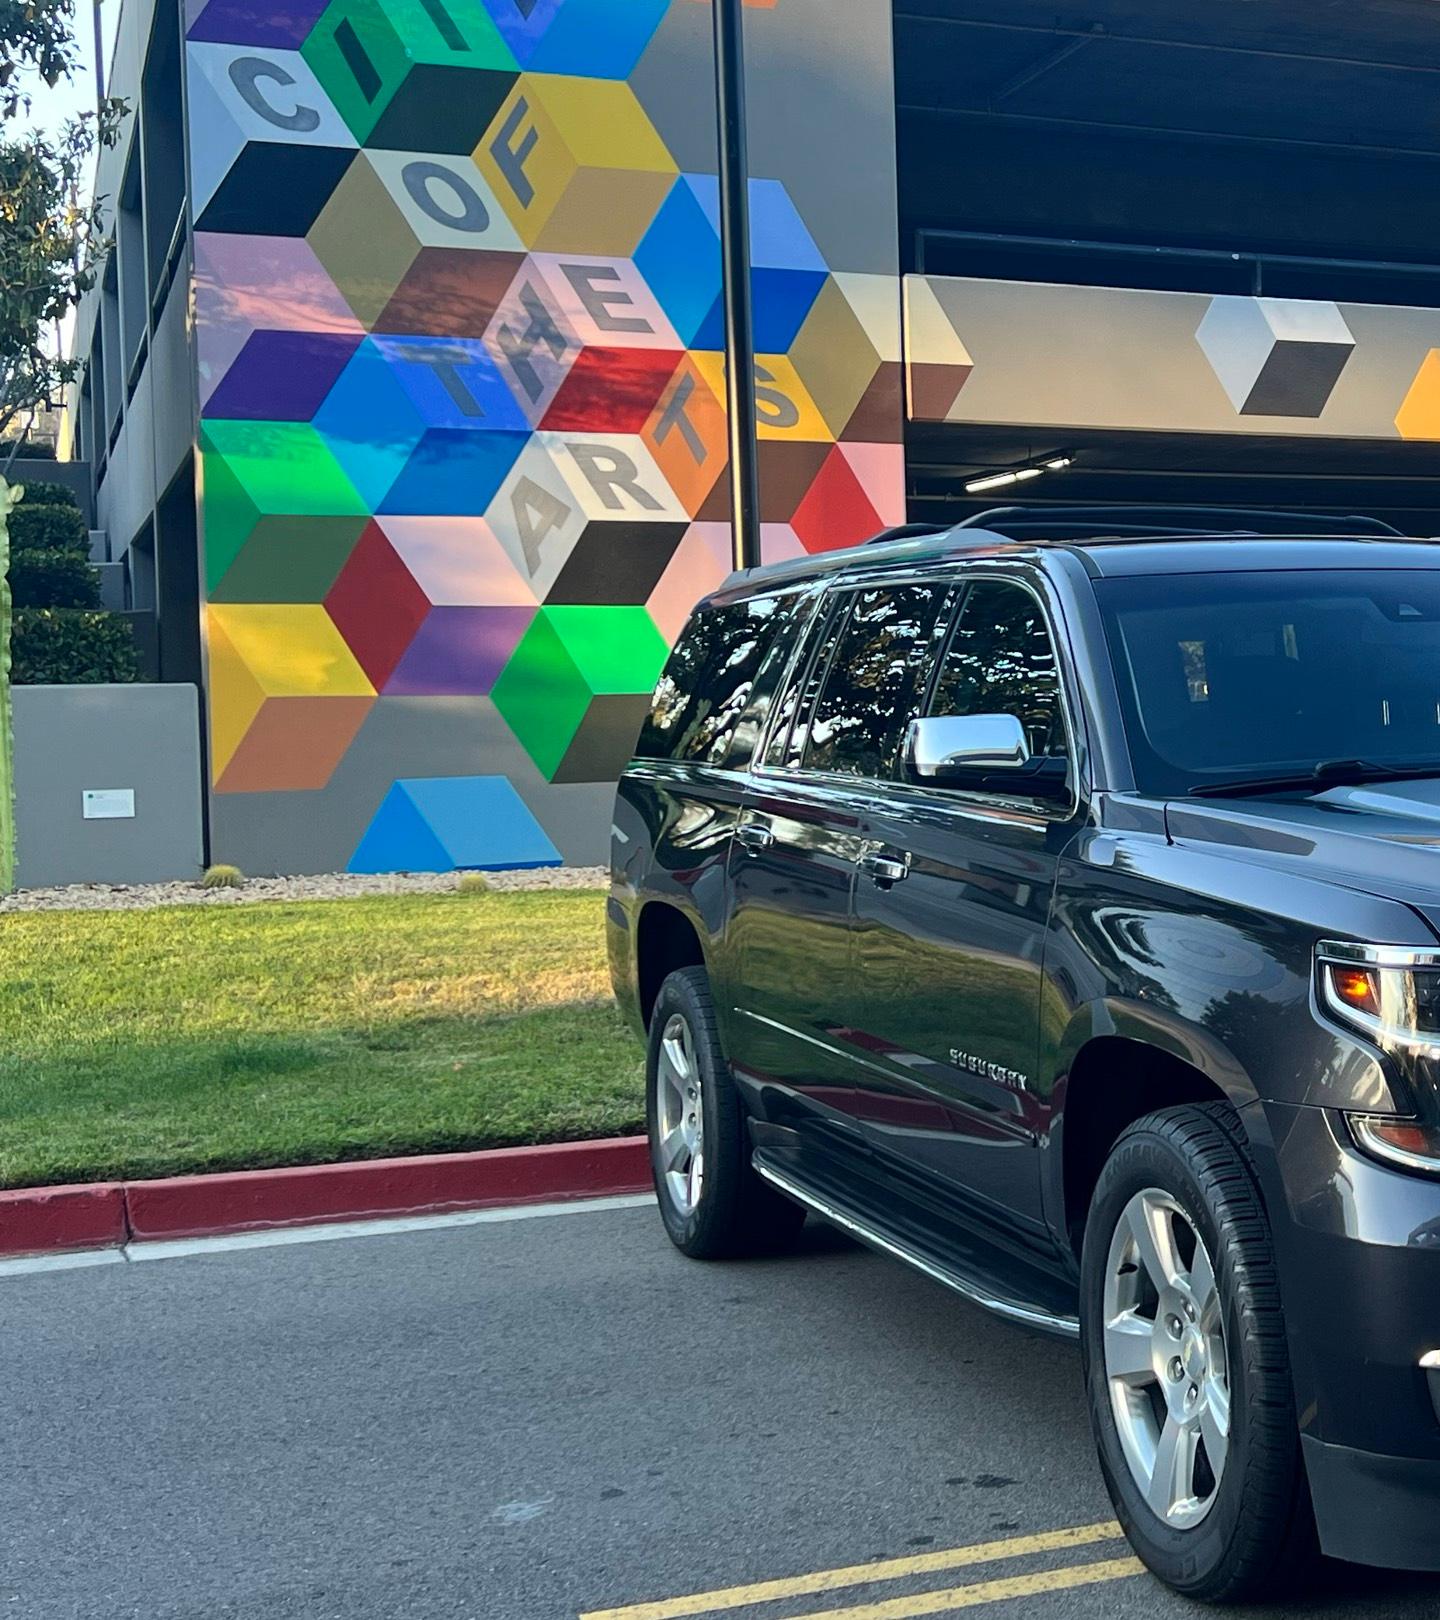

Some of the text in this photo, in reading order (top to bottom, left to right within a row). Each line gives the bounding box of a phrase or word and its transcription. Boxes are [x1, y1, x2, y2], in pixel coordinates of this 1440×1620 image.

[401, 95, 538, 232] OF
[400, 263, 655, 418] THE
[511, 365, 800, 579] ARTS
[949, 1048, 1027, 1090] SUBURBAN
